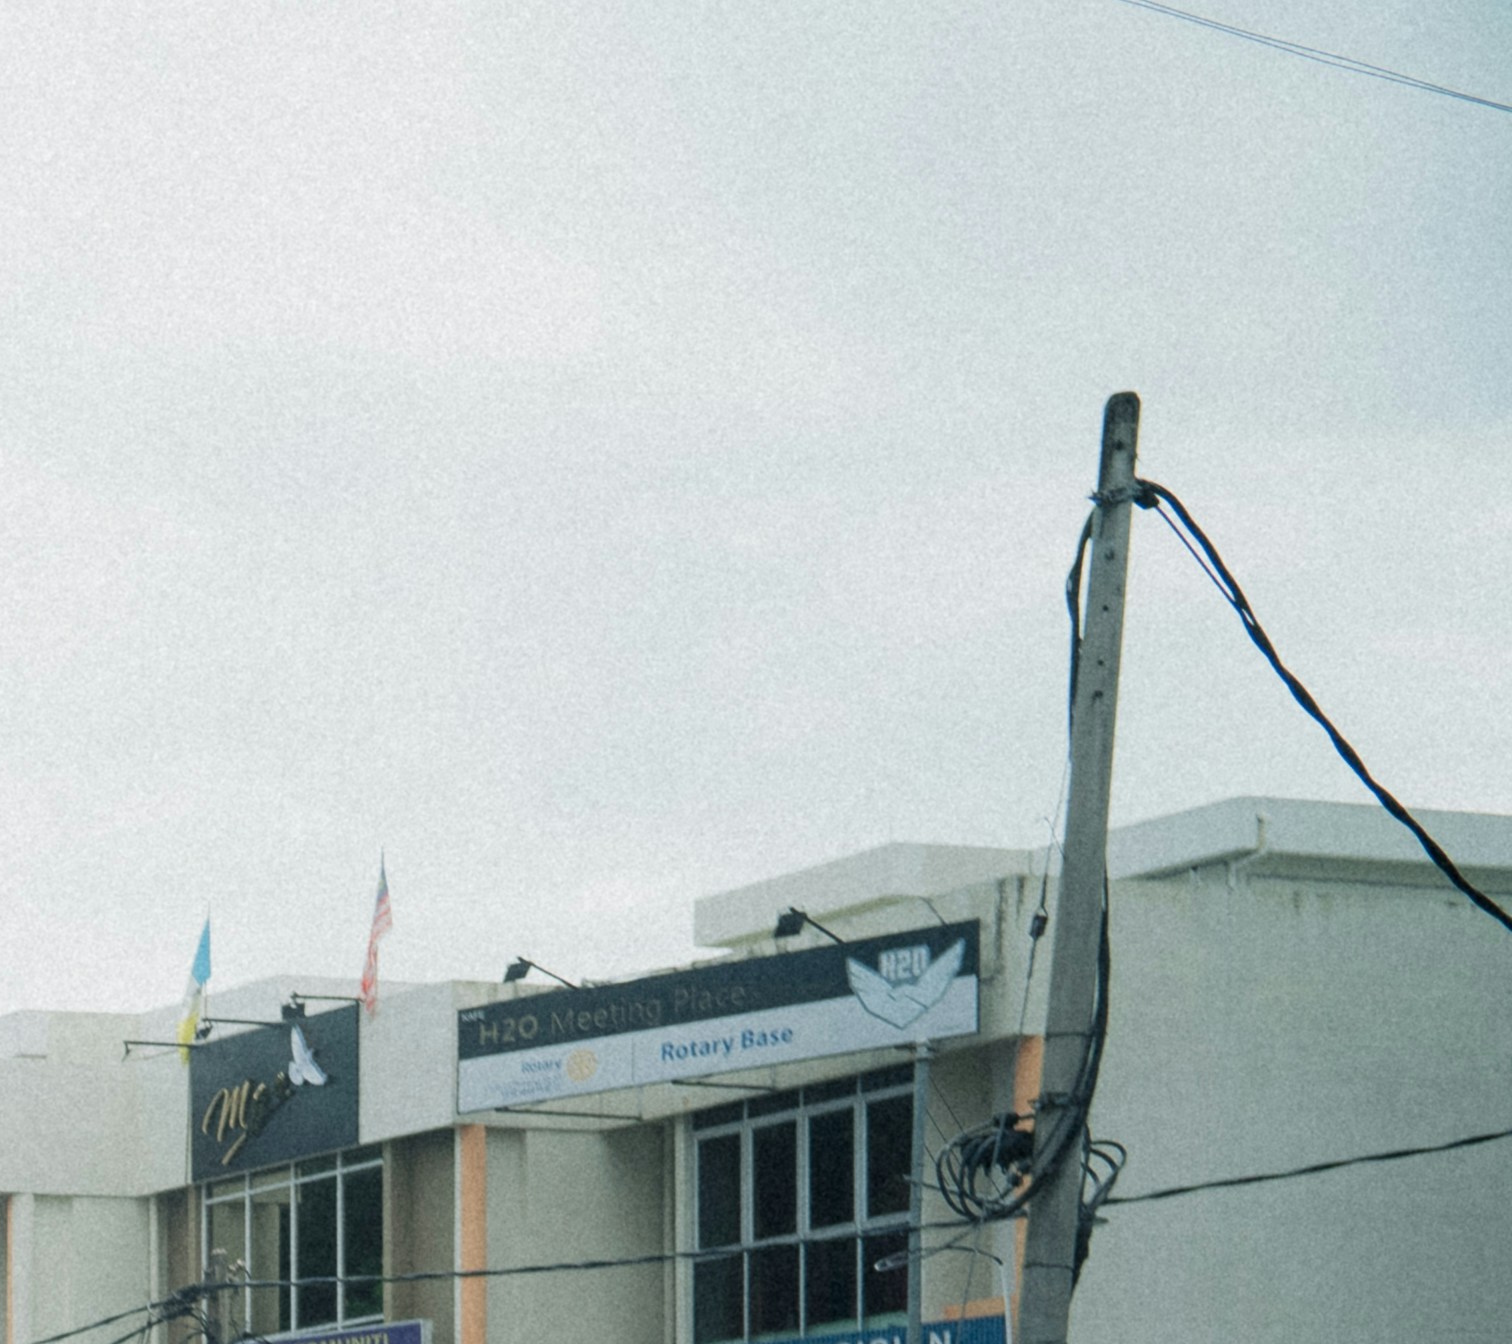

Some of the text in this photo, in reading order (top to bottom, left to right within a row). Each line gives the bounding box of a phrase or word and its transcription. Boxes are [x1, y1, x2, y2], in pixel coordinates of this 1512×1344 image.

[478, 984, 747, 1047] H2O Meeting Place
[660, 1023, 794, 1064] Rotary Base
